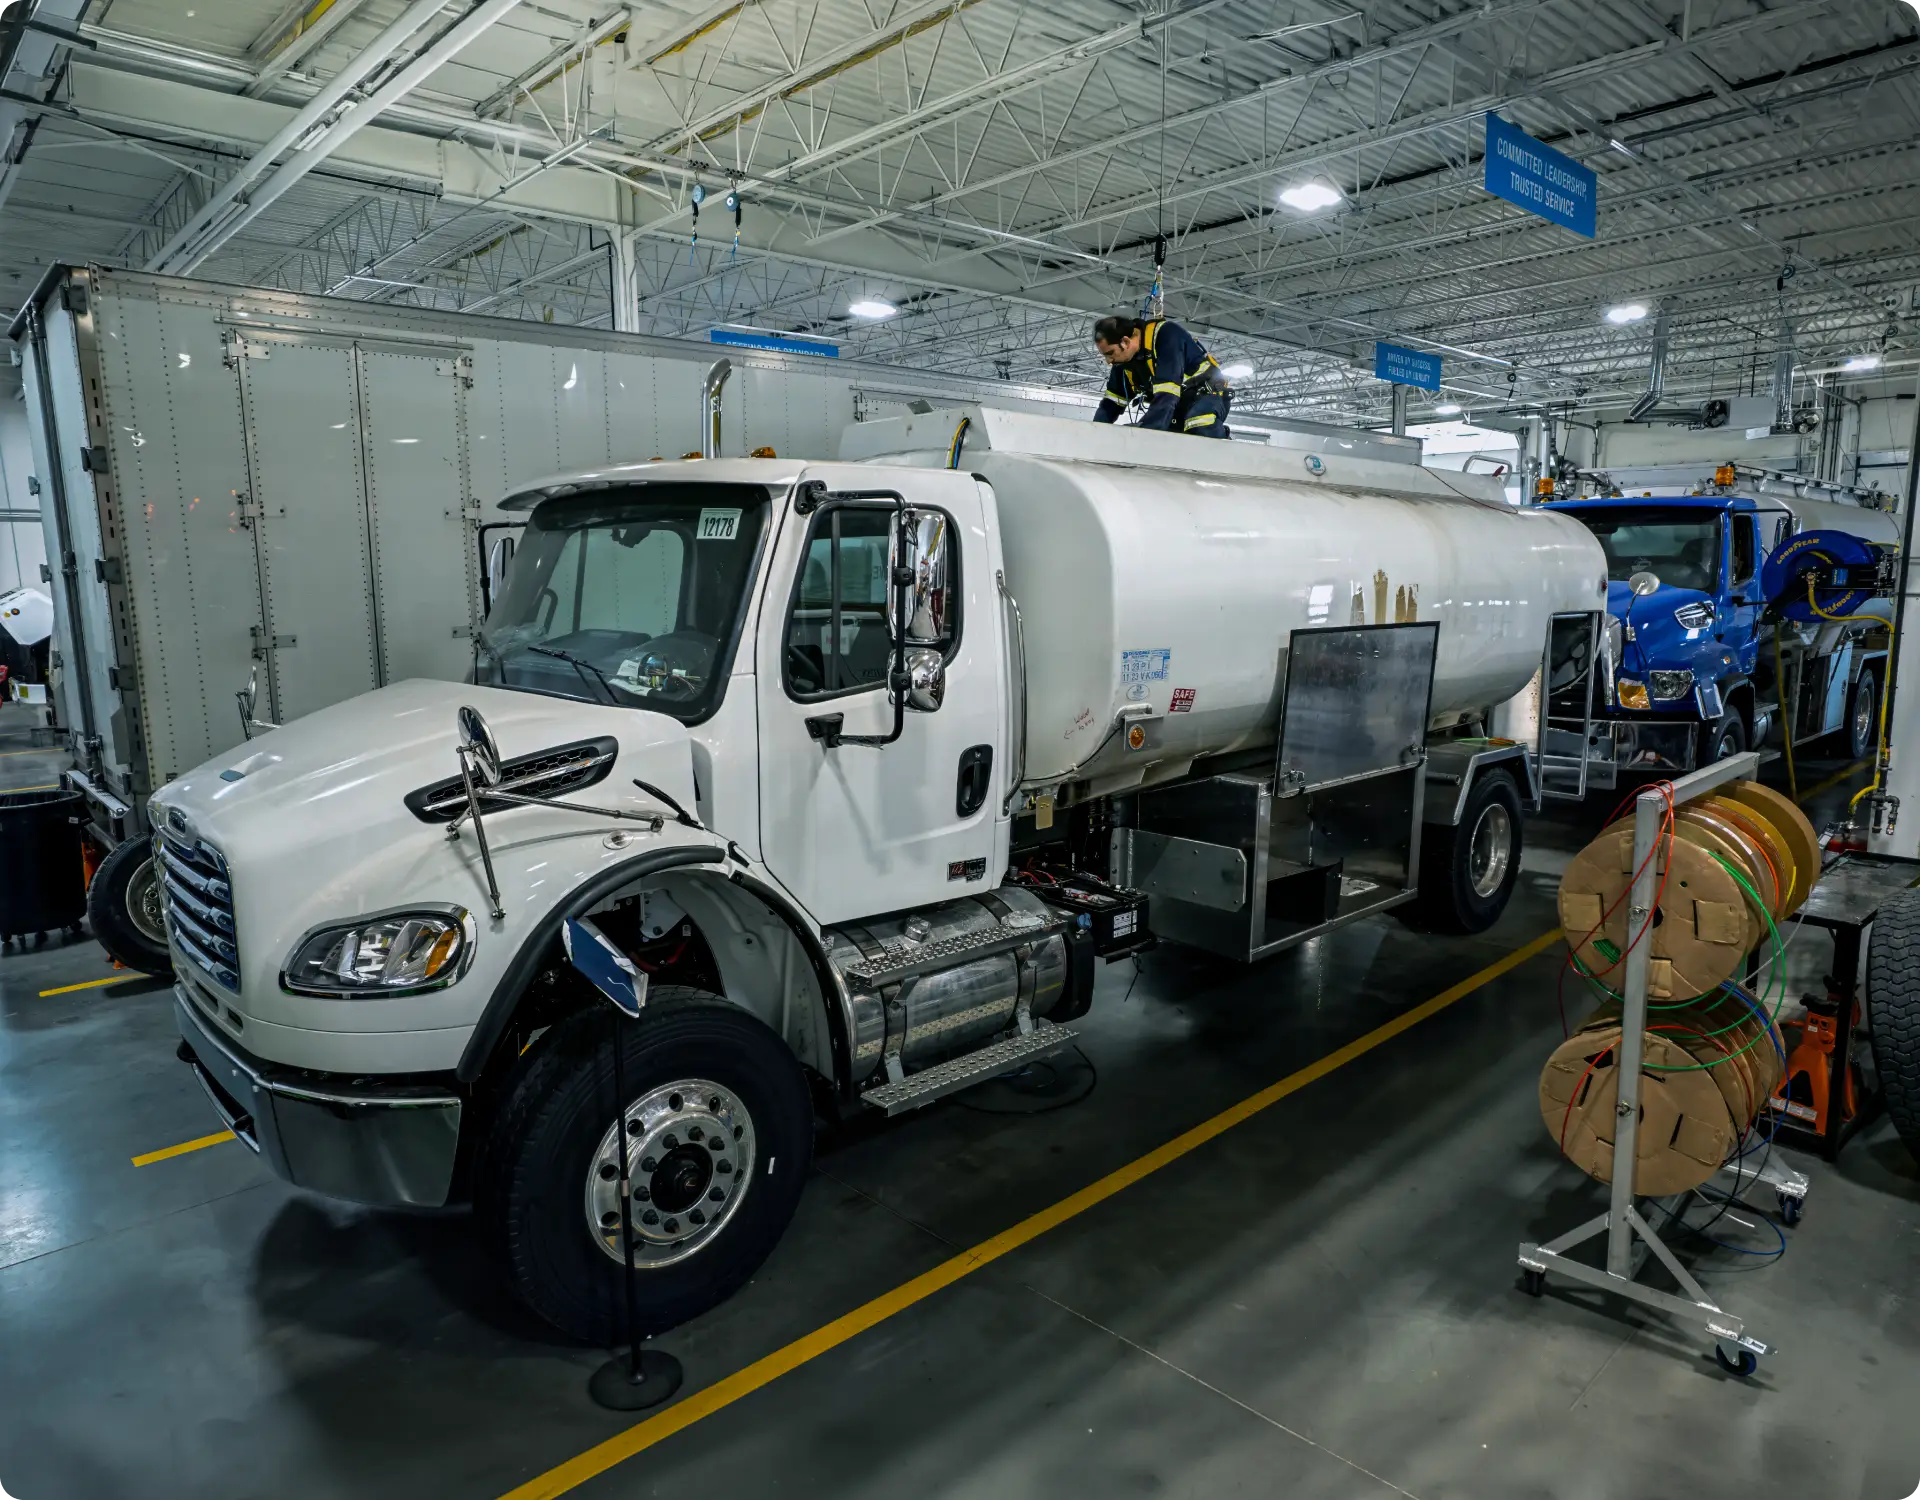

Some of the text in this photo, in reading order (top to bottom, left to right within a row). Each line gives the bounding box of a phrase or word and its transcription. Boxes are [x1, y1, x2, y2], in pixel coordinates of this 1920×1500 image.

[1497, 137, 1588, 202] COMMITTED LEADERSHIP,
[1510, 171, 1575, 218] TRUSTED SERVICE
[703, 517, 735, 537] 12178
[1776, 538, 1820, 565] GOODYEAR
[1174, 689, 1195, 700] SAFE
